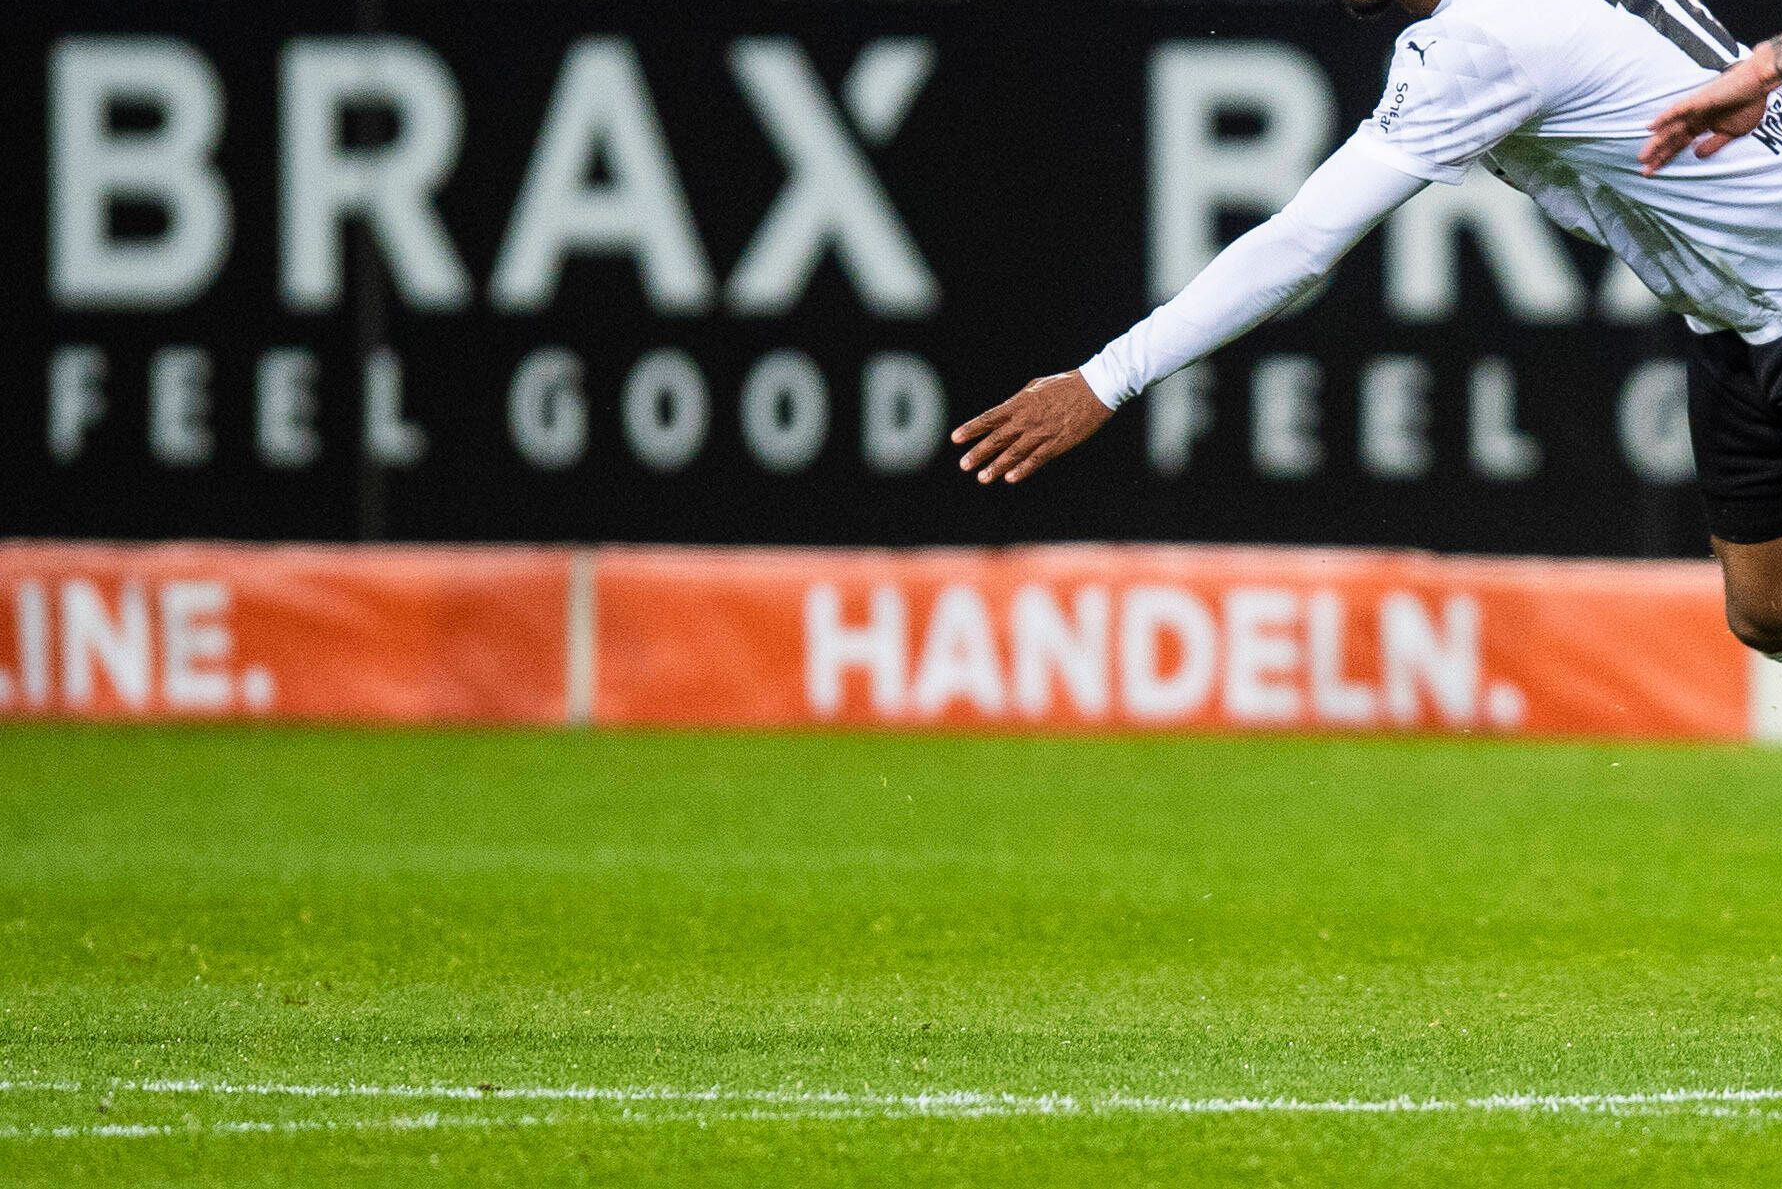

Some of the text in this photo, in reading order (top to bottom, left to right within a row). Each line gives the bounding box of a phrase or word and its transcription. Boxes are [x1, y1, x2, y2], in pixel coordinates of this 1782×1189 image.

[46, 36, 937, 318] BRAX
[46, 344, 950, 478] FEEL GOOD
[1147, 354, 1544, 480] FEEL
[803, 584, 1527, 728] HANDELN.
